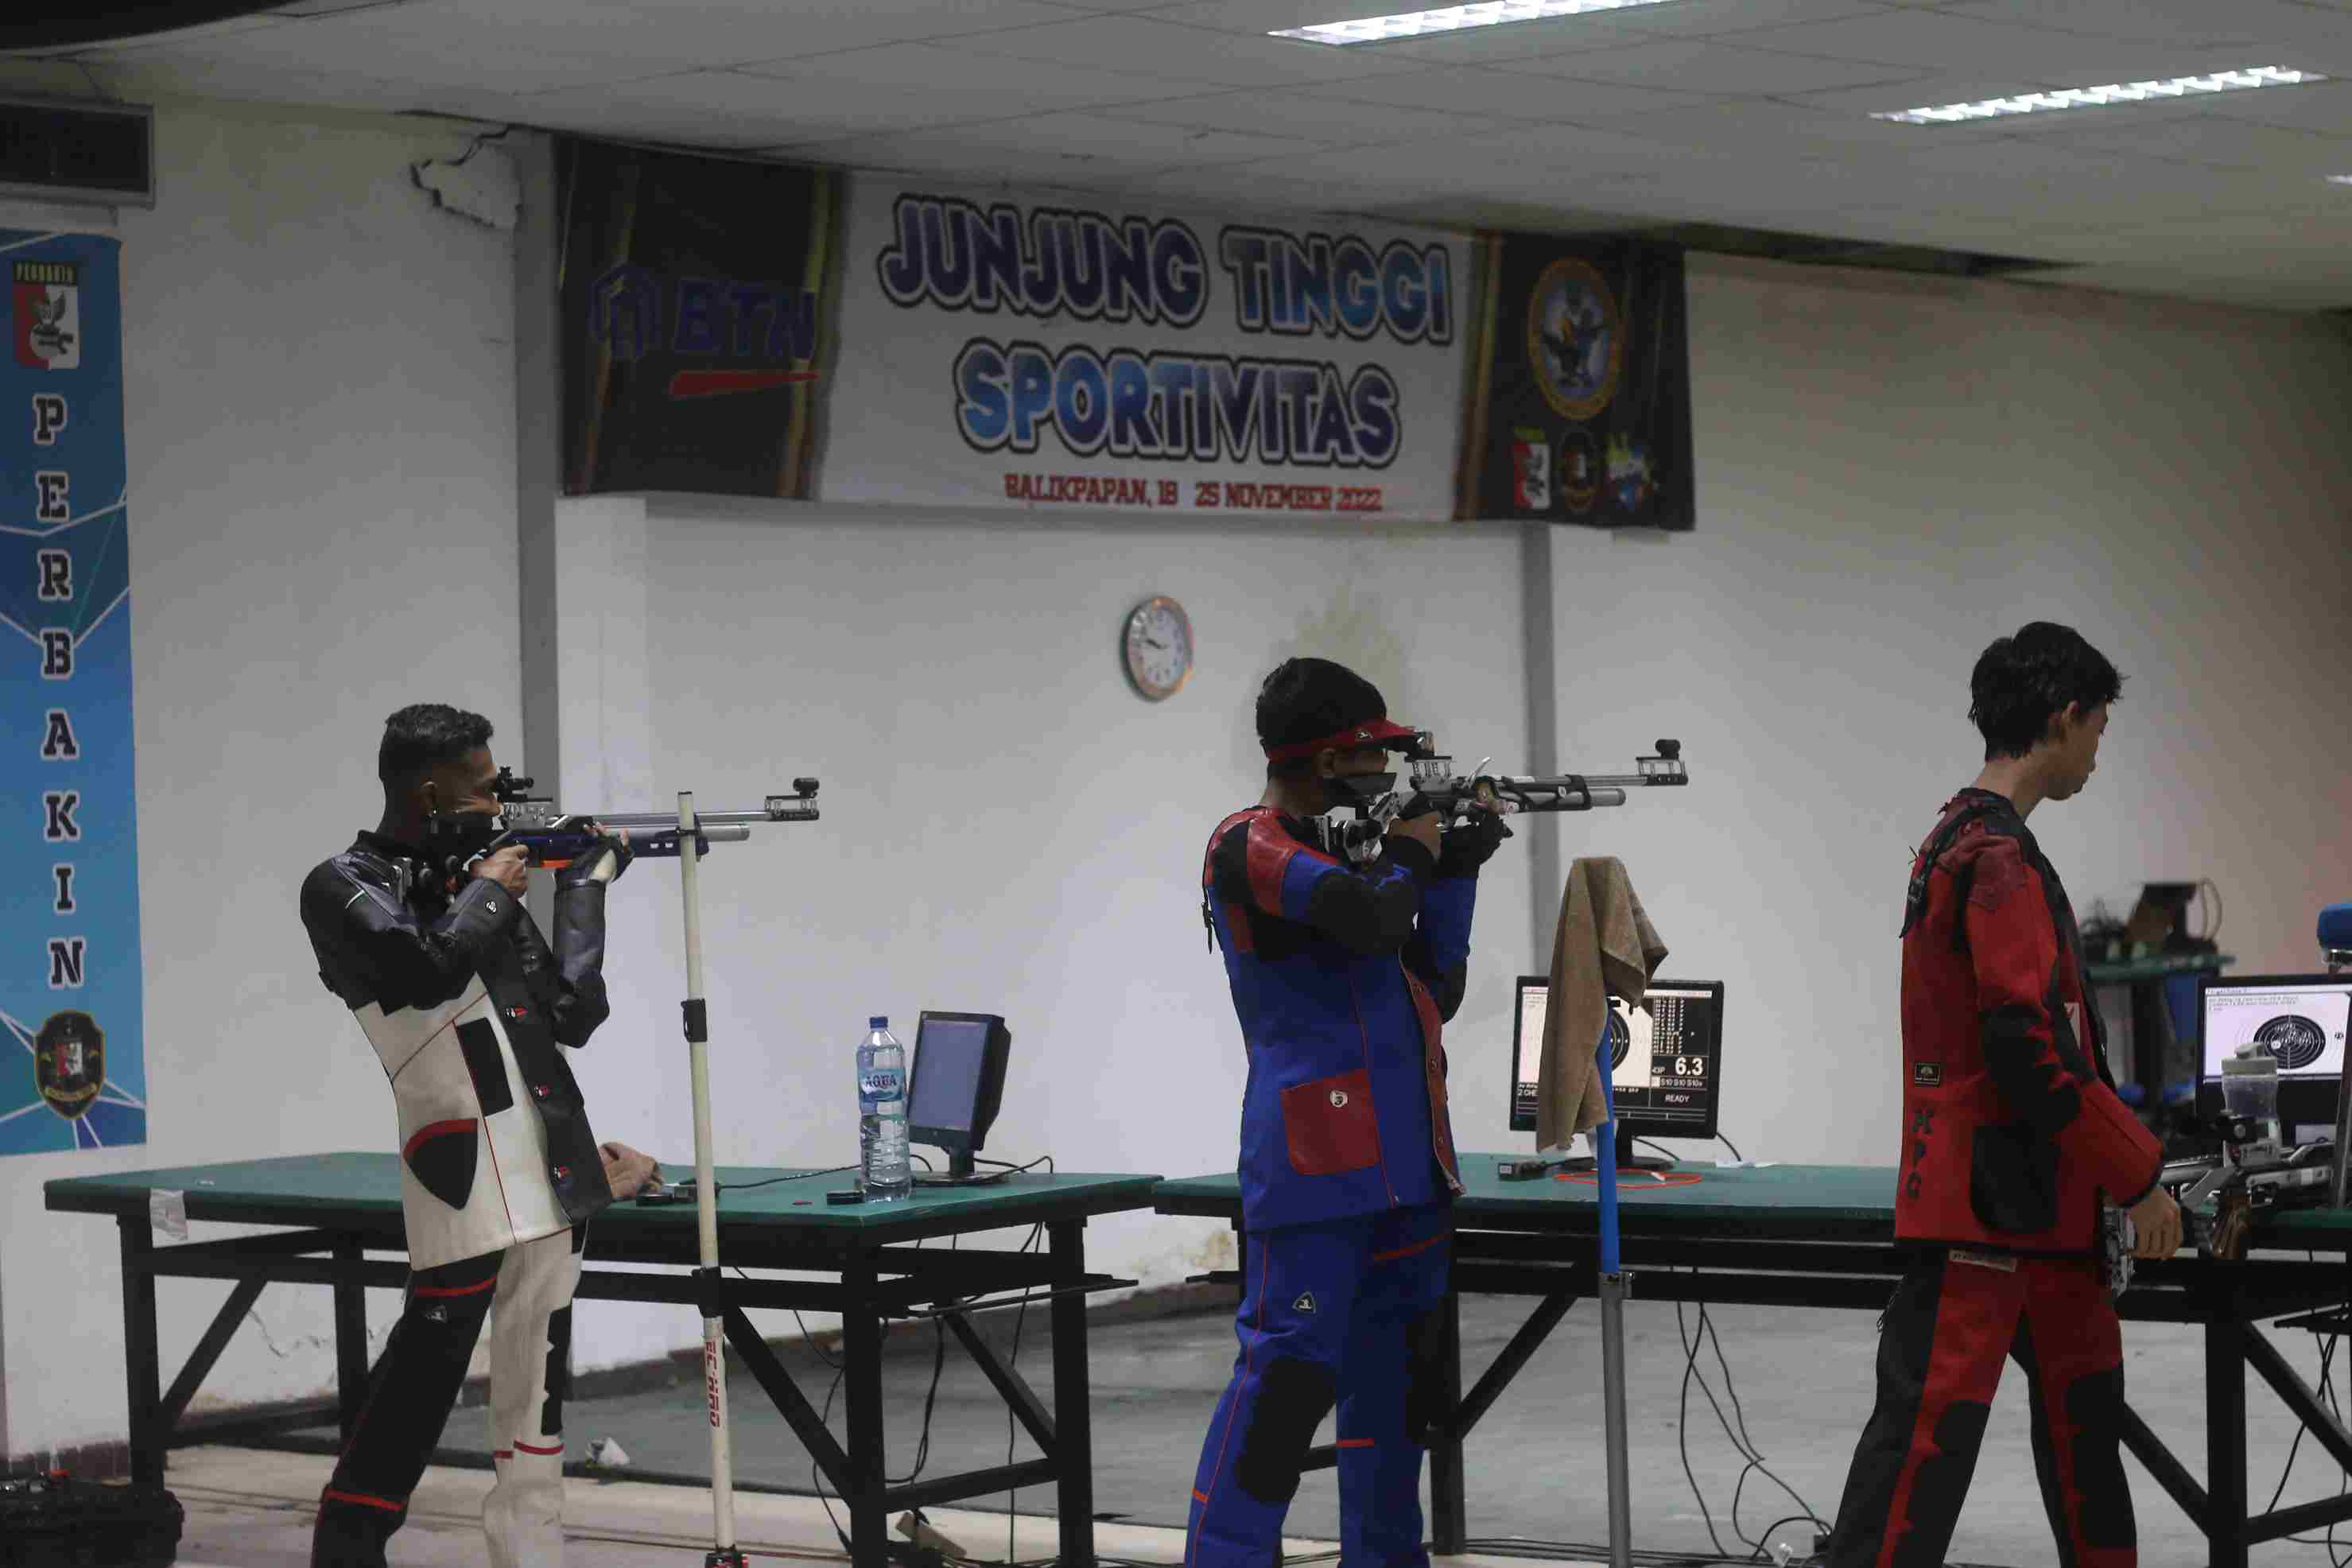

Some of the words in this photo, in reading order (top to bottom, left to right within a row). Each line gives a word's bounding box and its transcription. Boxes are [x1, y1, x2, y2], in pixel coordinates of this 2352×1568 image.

[878, 194, 1209, 328] JUNJUNG
[1220, 225, 1453, 345] TINGGI
[674, 279, 815, 357] BTN
[955, 337, 1402, 468] SPORTIVITAS
[1225, 483, 1333, 511] NOVEMBER
[1336, 486, 1383, 511] 2022
[32, 392, 86, 989] PERBAKIN
[865, 1073, 898, 1089] AQUA
[1675, 1057, 1703, 1076] 6.3
[1665, 1094, 1690, 1103] READY
